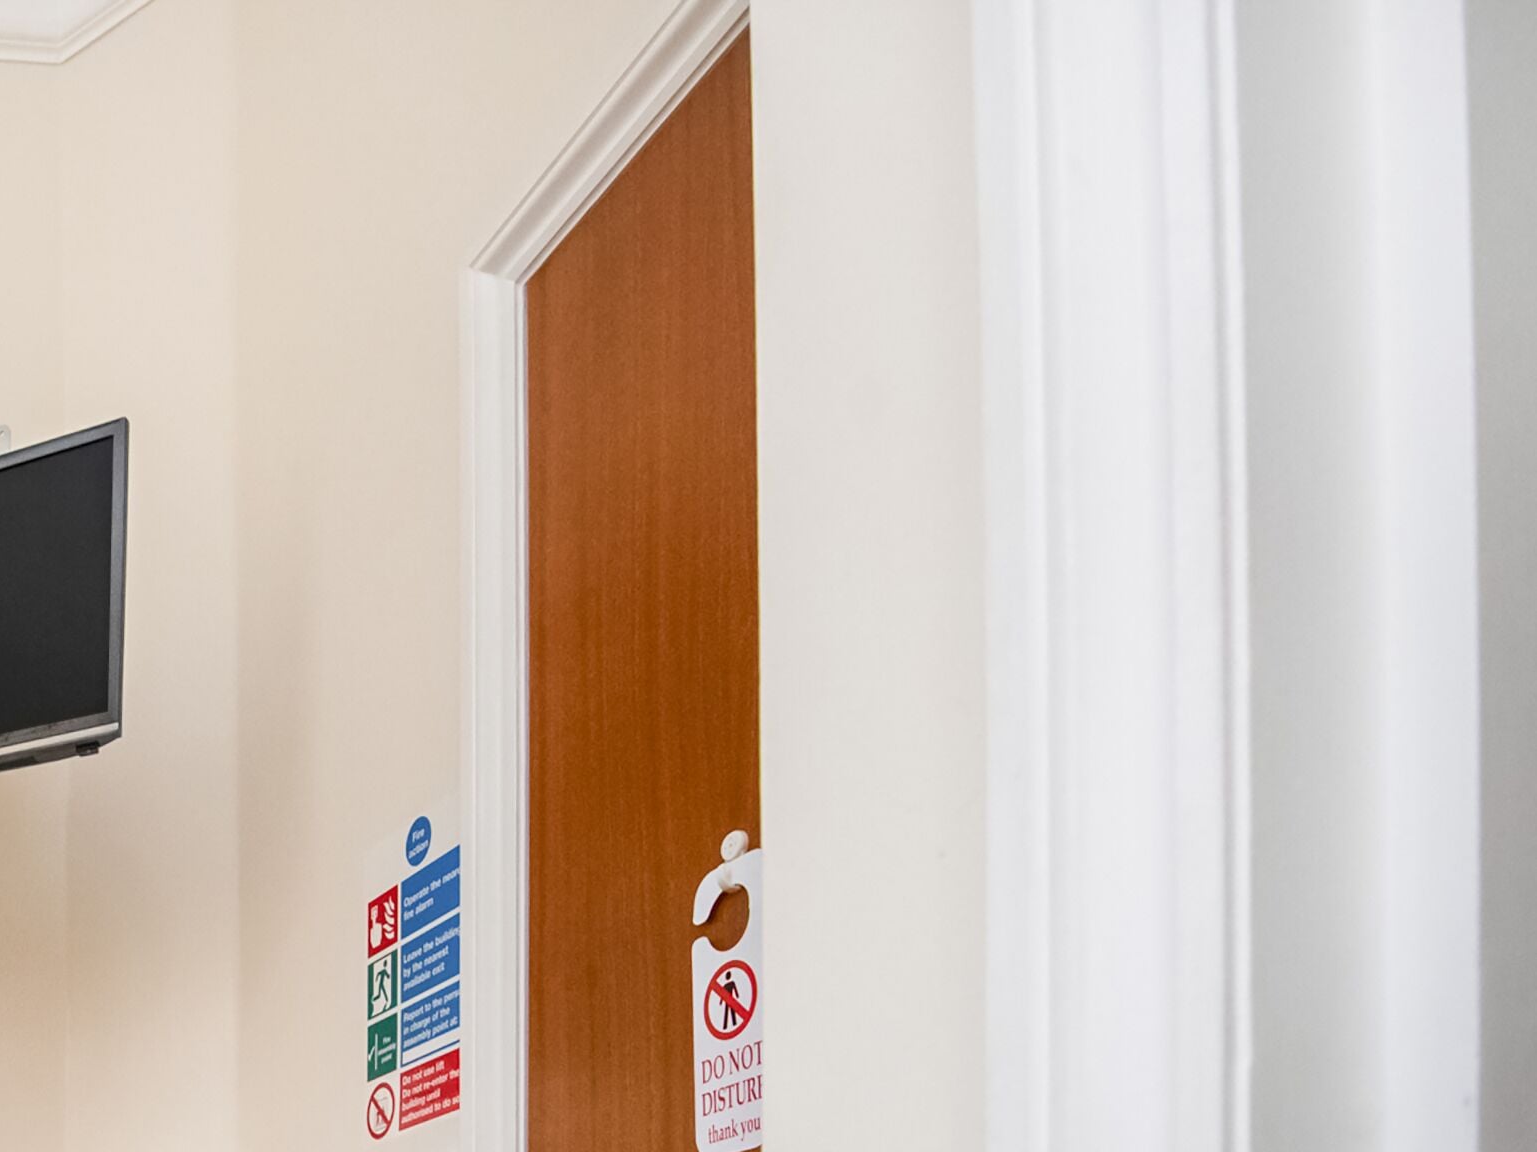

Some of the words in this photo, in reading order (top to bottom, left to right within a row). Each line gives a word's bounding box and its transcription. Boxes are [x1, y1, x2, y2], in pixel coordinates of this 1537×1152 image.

[403, 886, 430, 907] Operate
[430, 878, 442, 891] the
[403, 947, 423, 964] Leave
[423, 941, 434, 953] the
[403, 967, 411, 978] by
[412, 961, 423, 973] the
[424, 944, 449, 966] nearest
[432, 961, 445, 976] exit
[403, 1005, 424, 1022] Report
[424, 1003, 432, 1012] to
[432, 997, 443, 1008] the
[410, 1015, 431, 1033] charge
[432, 1010, 439, 1021] of
[439, 1006, 451, 1018] the
[432, 1019, 449, 1037] point
[402, 1075, 411, 1086] Do
[412, 1069, 423, 1081] not
[423, 1065, 435, 1077] use
[435, 1060, 445, 1072] lift
[701, 1054, 726, 1085] DO
[728, 1040, 763, 1075] NOT
[402, 1088, 411, 1099] Do
[411, 1083, 423, 1095] not
[426, 1087, 441, 1102] until
[434, 1102, 442, 1112] to
[442, 1098, 452, 1108] do
[708, 1118, 739, 1144] thank
[740, 1116, 761, 1142] you
